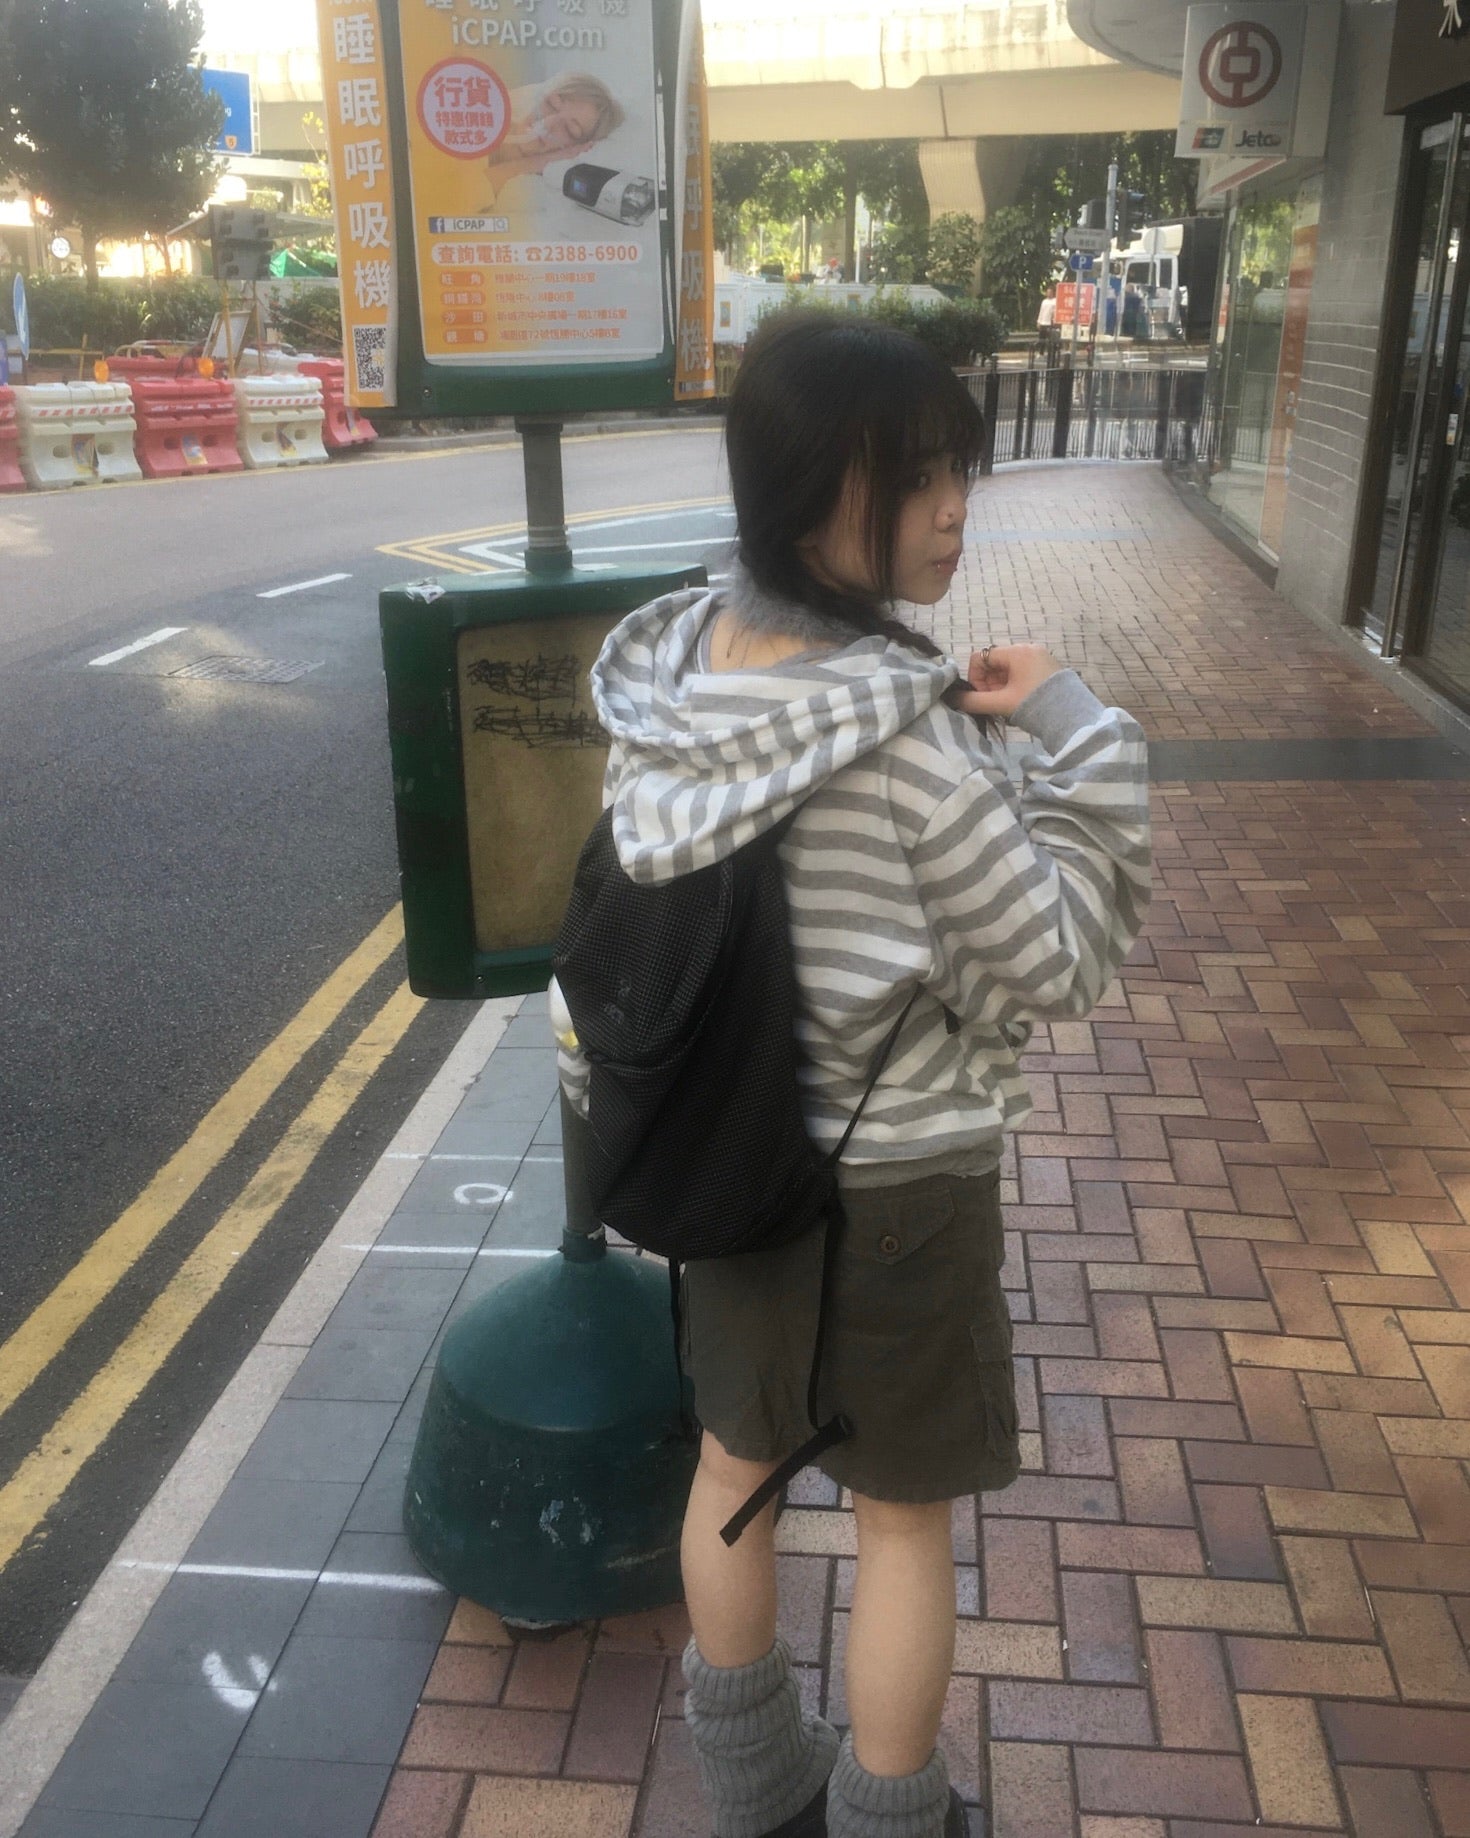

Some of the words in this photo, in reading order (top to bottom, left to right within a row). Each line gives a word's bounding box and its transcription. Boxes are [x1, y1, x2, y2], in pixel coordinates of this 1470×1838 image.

[451, 15, 606, 49] iCPAP.com
[433, 77, 493, 108] 行貨
[332, 12, 393, 309] 睡眠呼吸機
[452, 219, 486, 231] iCPAP
[437, 244, 519, 265] 查詢電話:
[543, 245, 638, 263] 2388-6900
[1078, 255, 1087, 269] P
